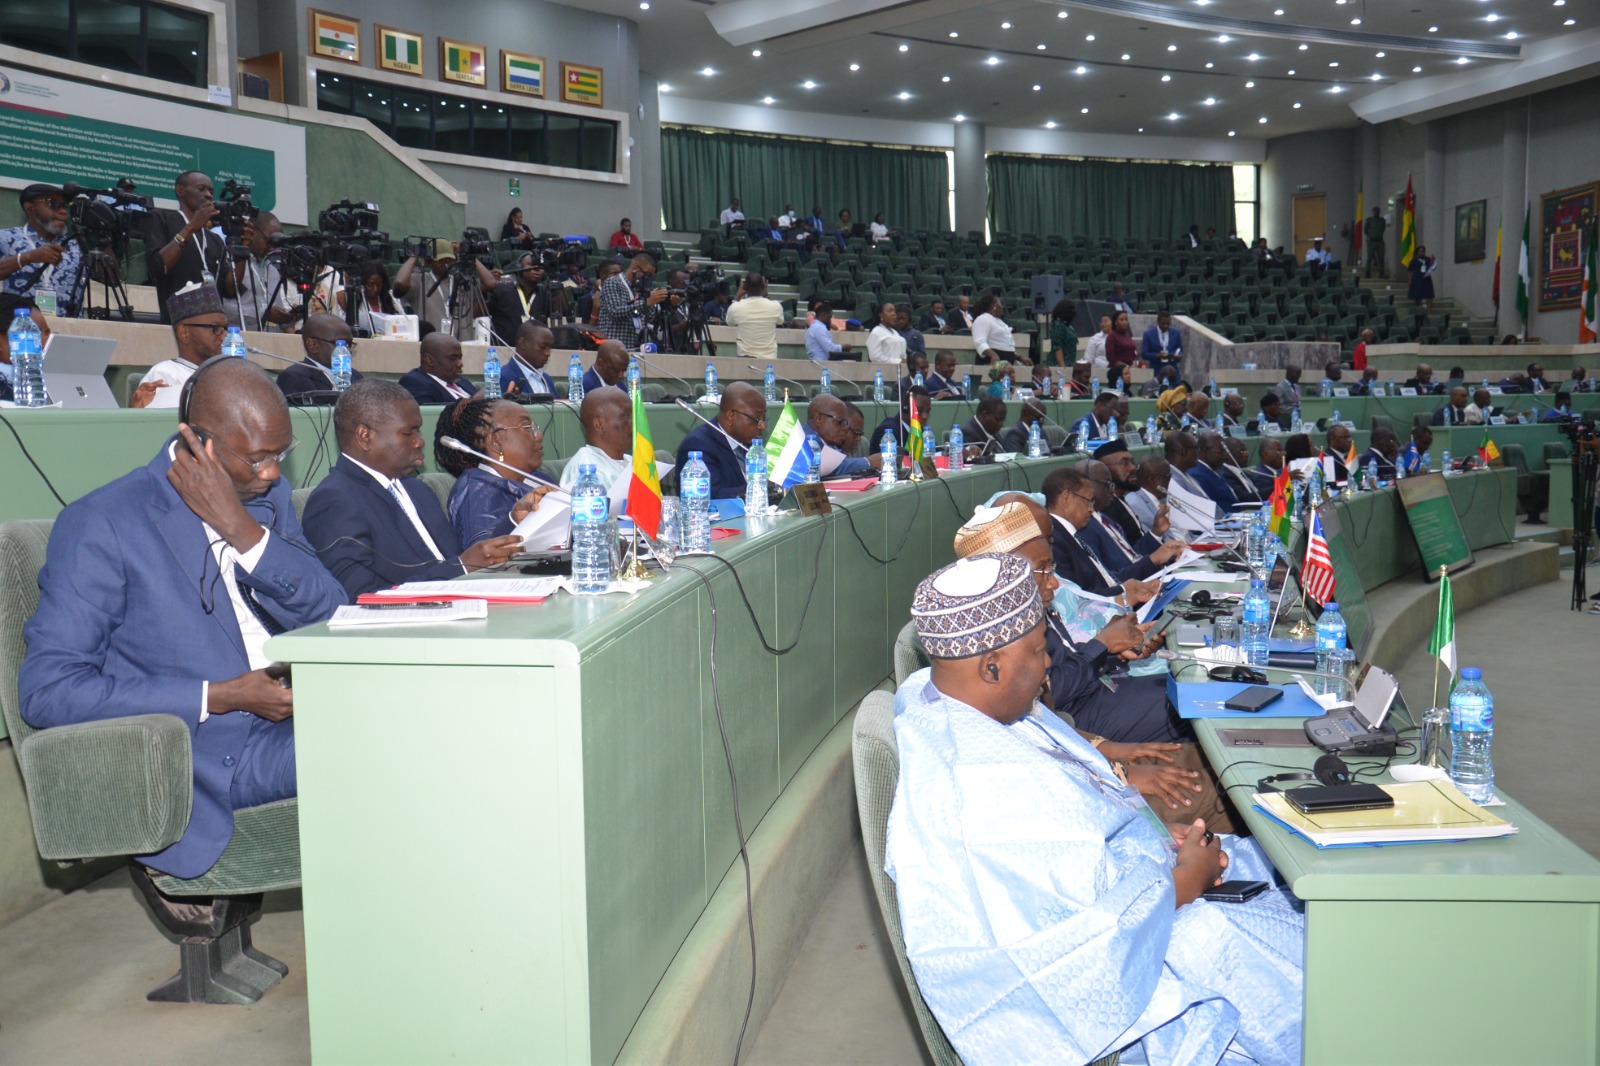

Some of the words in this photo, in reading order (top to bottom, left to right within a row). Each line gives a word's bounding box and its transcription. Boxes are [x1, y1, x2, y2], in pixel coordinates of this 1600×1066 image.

[393, 62, 412, 70] NIGERIA
[456, 72, 475, 81] SENEGAL
[219, 170, 234, 178] Abuja,
